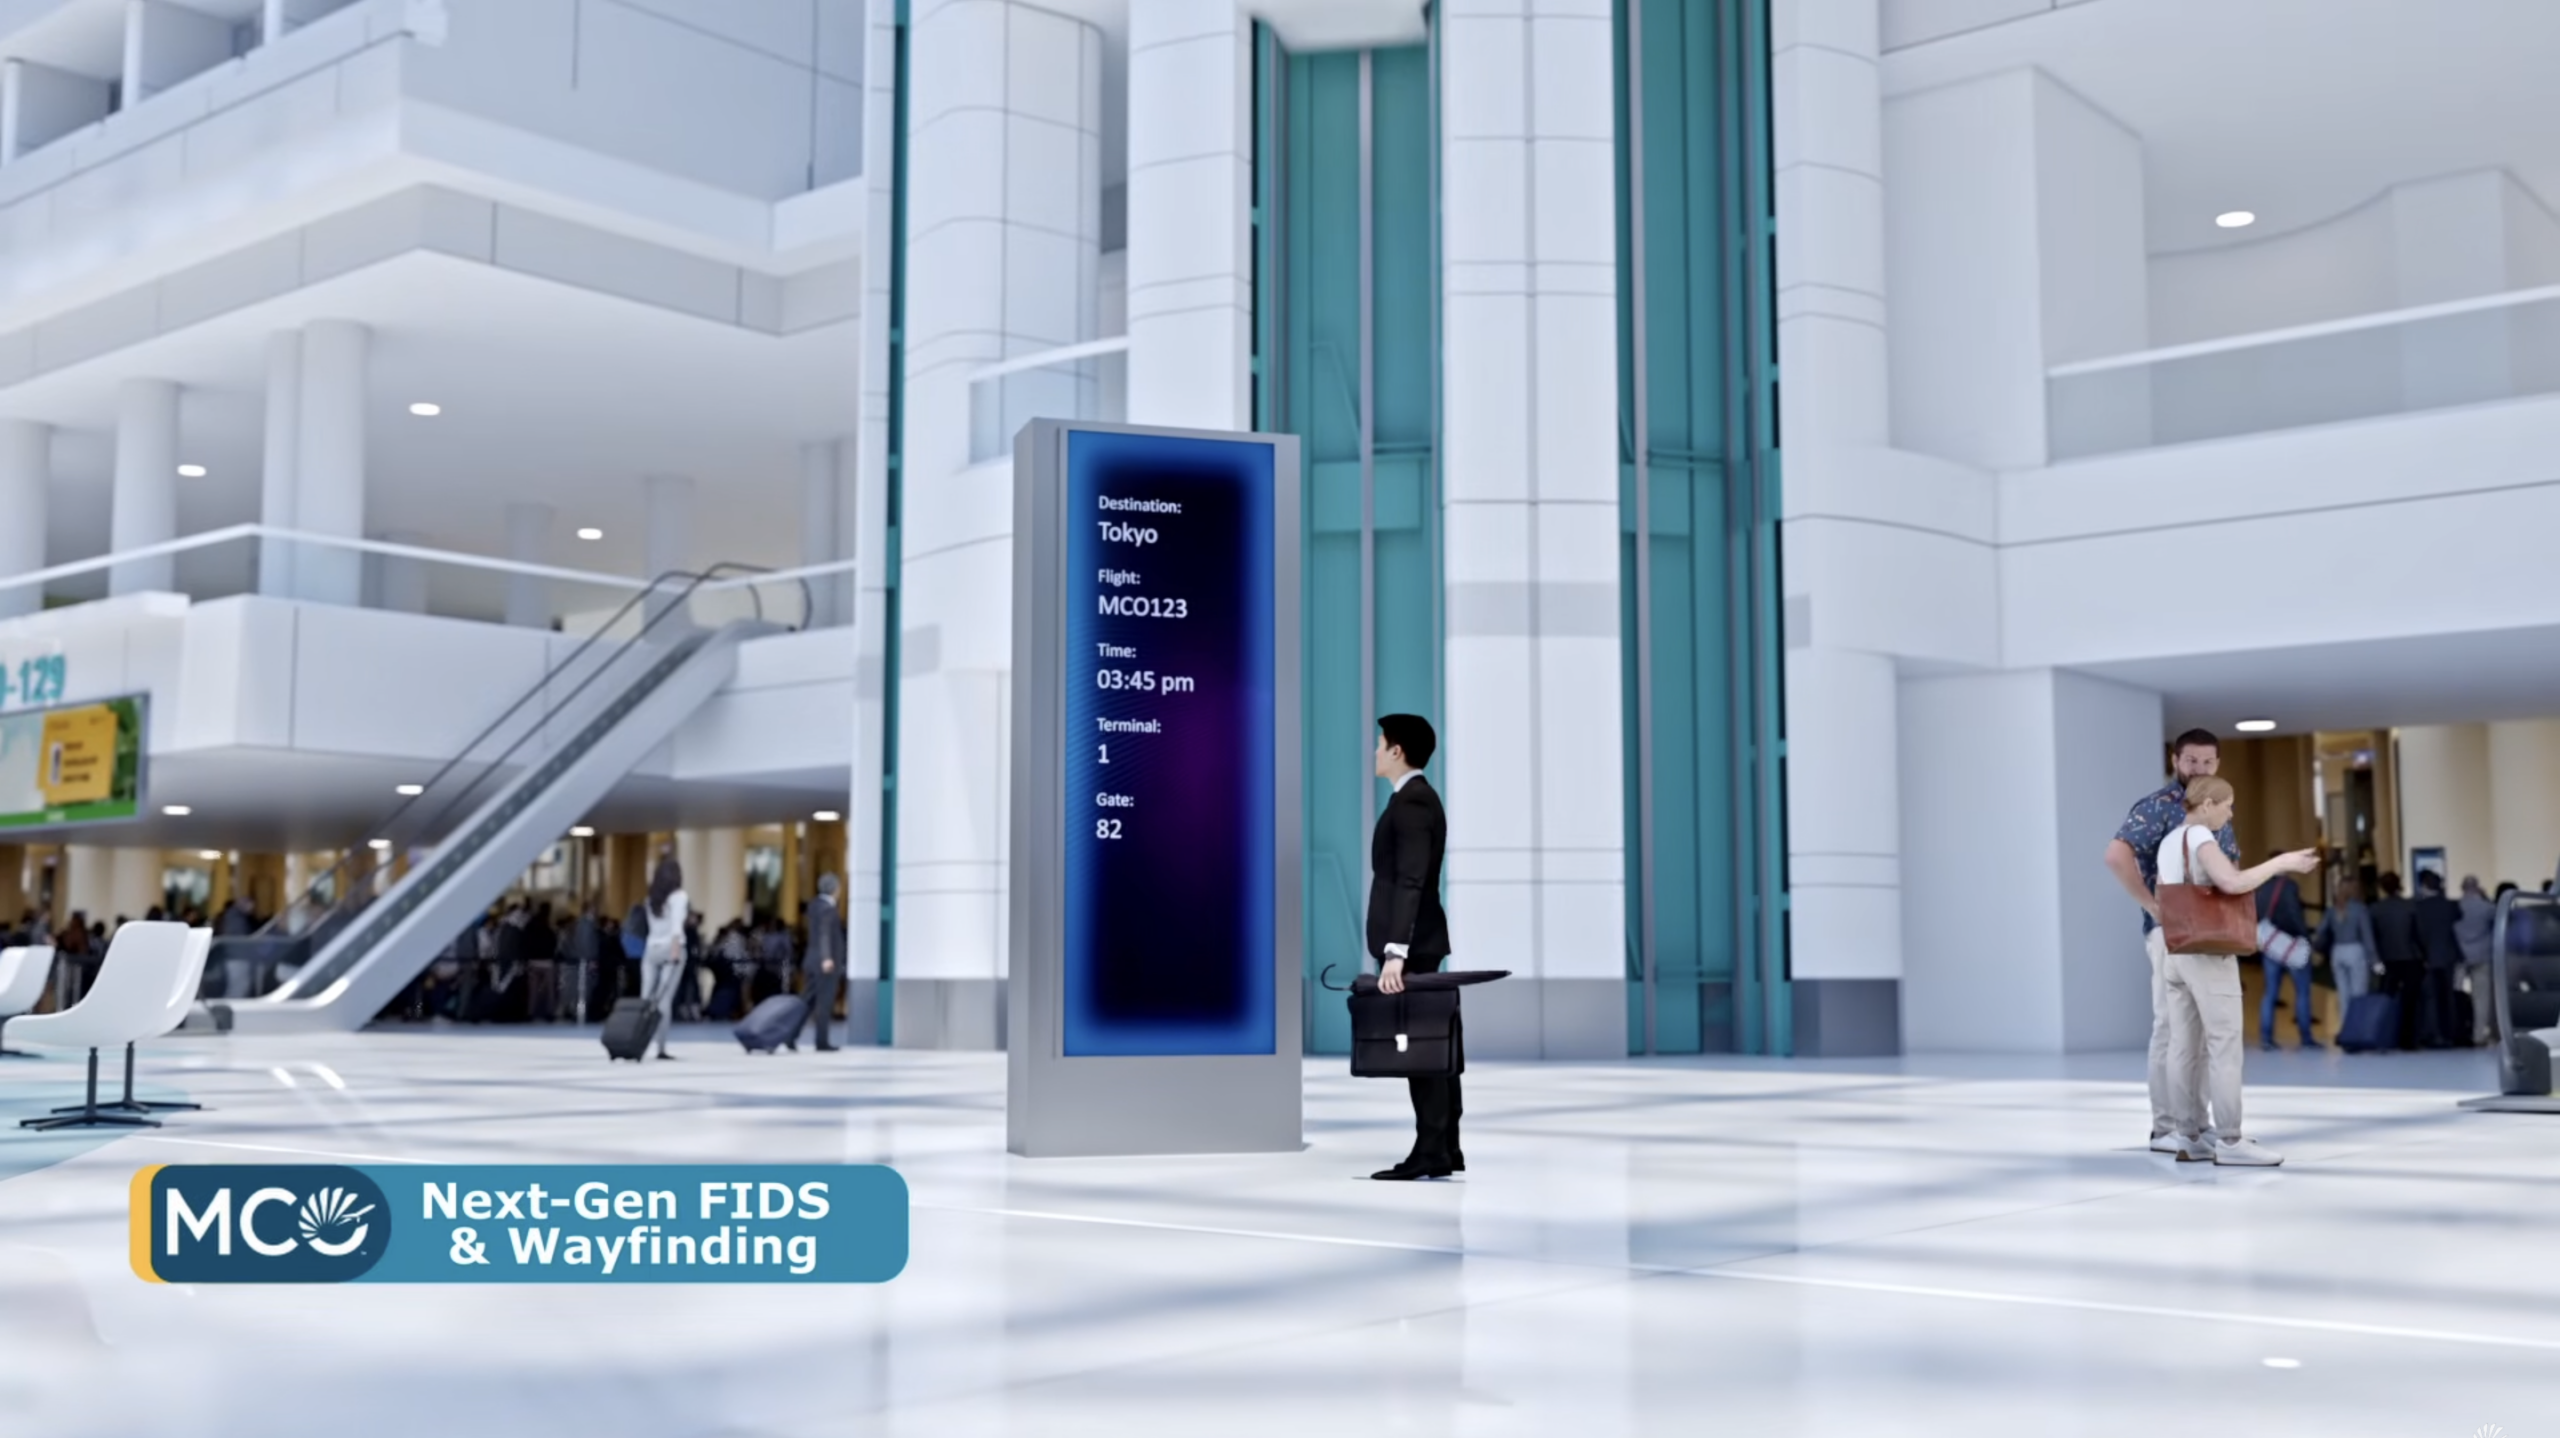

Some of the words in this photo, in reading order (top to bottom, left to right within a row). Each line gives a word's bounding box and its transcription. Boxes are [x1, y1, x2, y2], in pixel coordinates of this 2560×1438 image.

[1098, 495, 1182, 514] Destination:
[1098, 521, 1158, 547] Tokyo
[1098, 569, 1141, 587] Flight:
[1098, 595, 1188, 619] MCO123
[1097, 643, 1137, 658] Time:
[1097, 669, 1156, 691] 03:45
[1161, 674, 1194, 695] pm
[1097, 717, 1161, 734] Terminal:
[1098, 744, 1110, 764] 1
[1096, 792, 1134, 807] Gate:
[1096, 819, 1122, 839] 82
